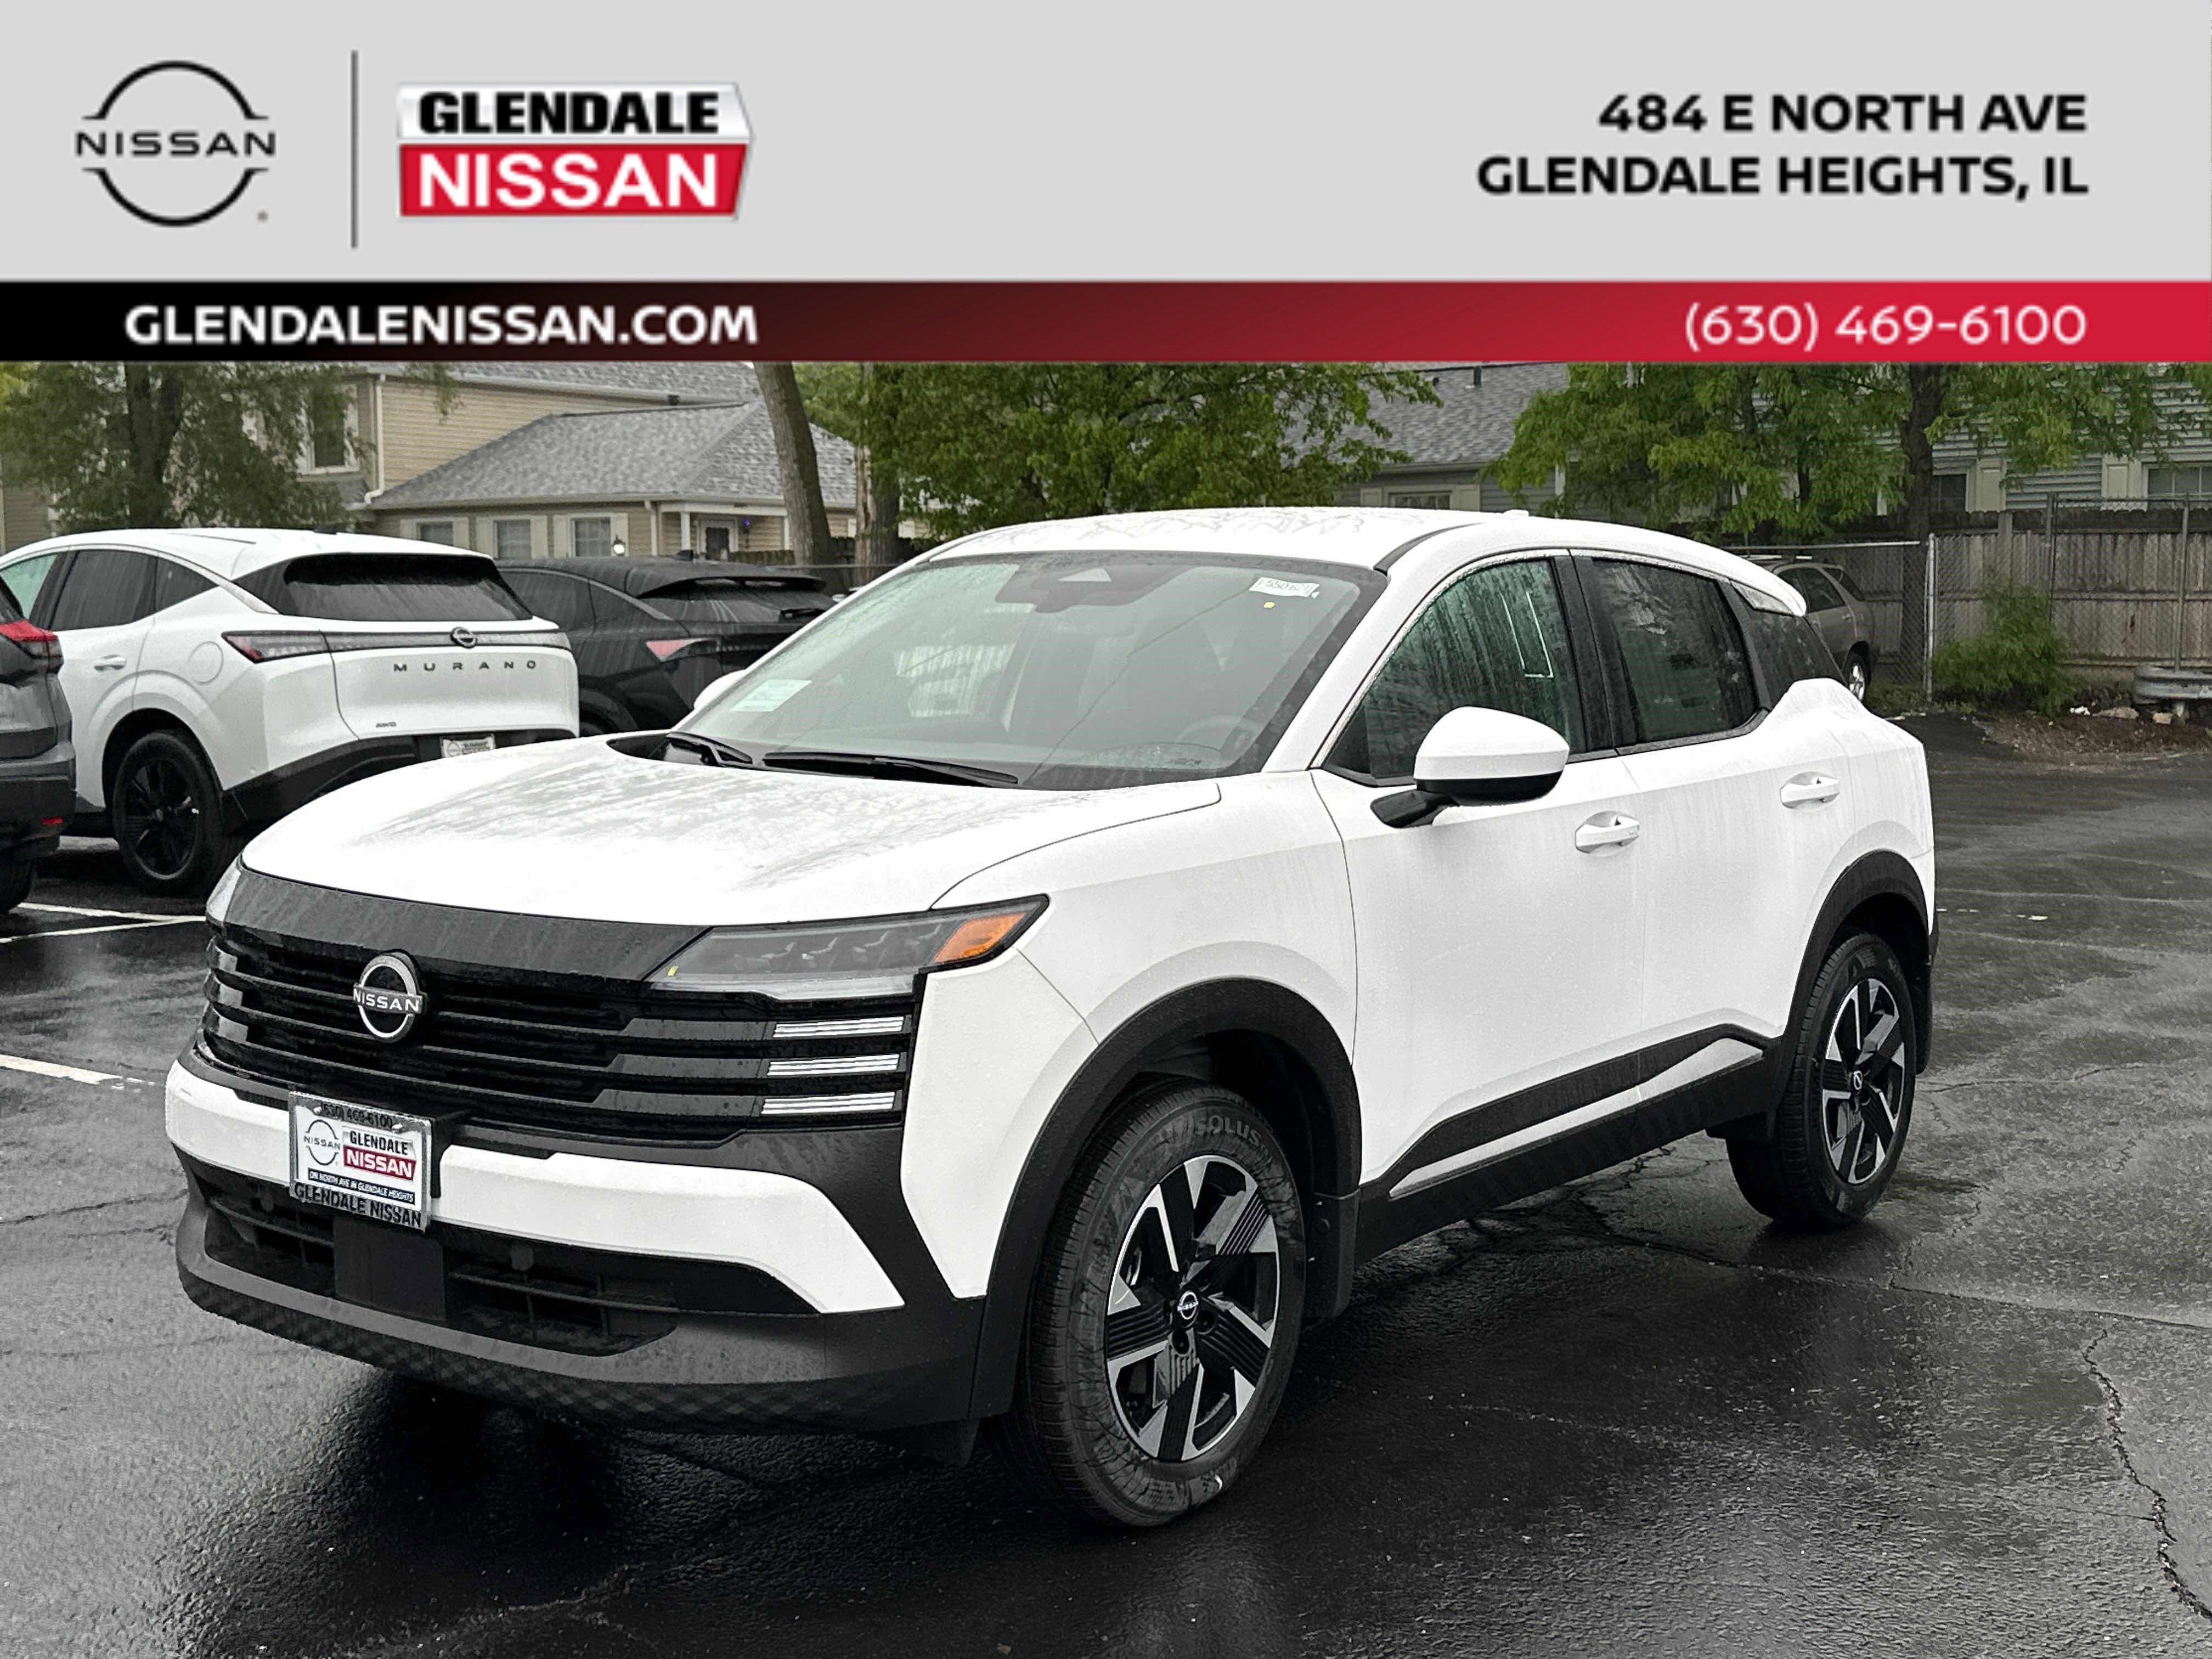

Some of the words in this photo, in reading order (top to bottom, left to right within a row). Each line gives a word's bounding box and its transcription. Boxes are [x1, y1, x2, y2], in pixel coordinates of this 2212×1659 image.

[393, 659, 537, 673] MURANO
[353, 988, 419, 1012] NISSAN
[303, 1135, 341, 1150] NISSAN
[349, 1130, 409, 1155] GLENDALE
[346, 1148, 412, 1178] NISSAN
[295, 1182, 366, 1214] GLENDALE
[369, 1203, 422, 1228] NISSAN
